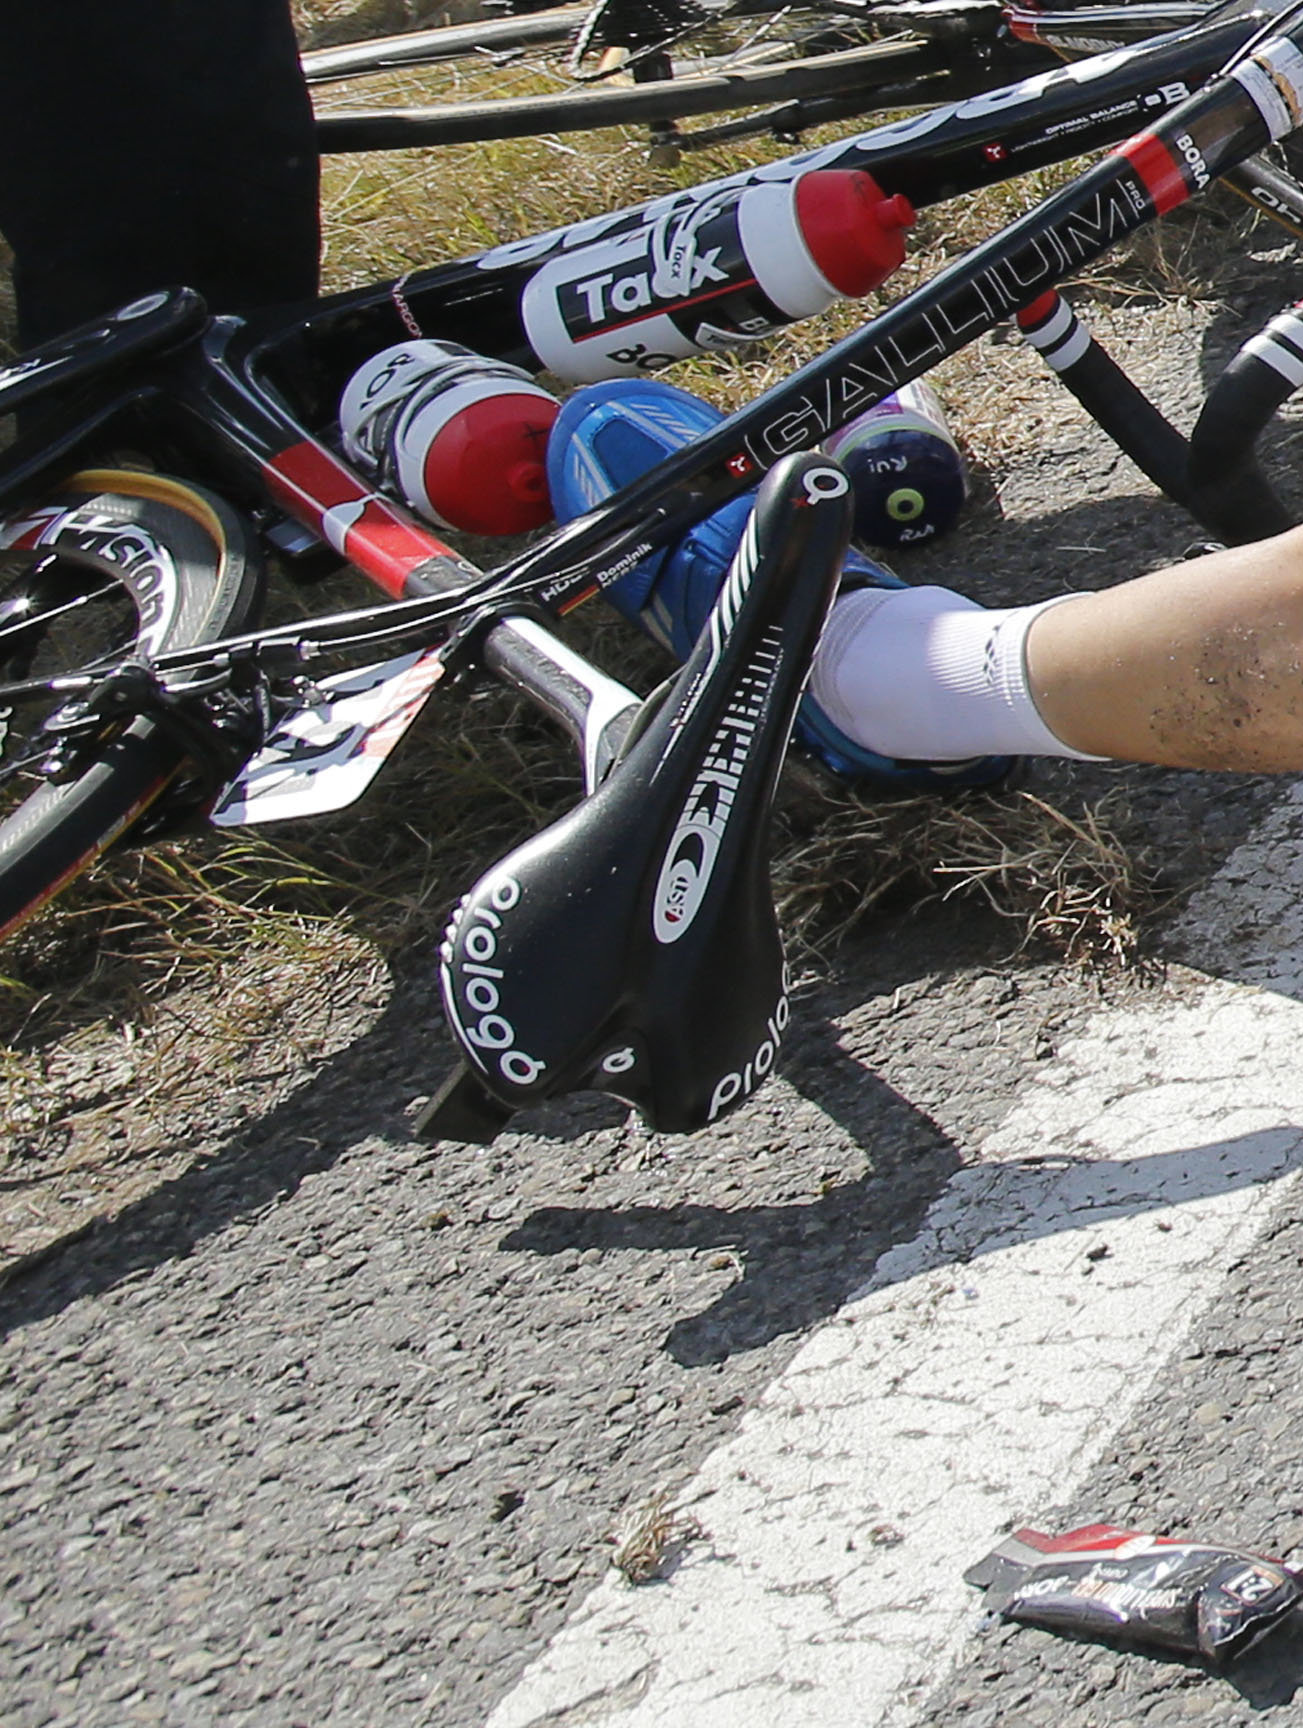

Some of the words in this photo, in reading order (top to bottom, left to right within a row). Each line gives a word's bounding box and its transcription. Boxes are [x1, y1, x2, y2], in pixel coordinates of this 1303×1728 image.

[1089, 98, 1139, 120] BALANCE
[1175, 134, 1211, 189] BORA
[1124, 180, 1146, 210] PRO
[762, 187, 1128, 459] GALLIUM
[596, 541, 653, 584] Dominik
